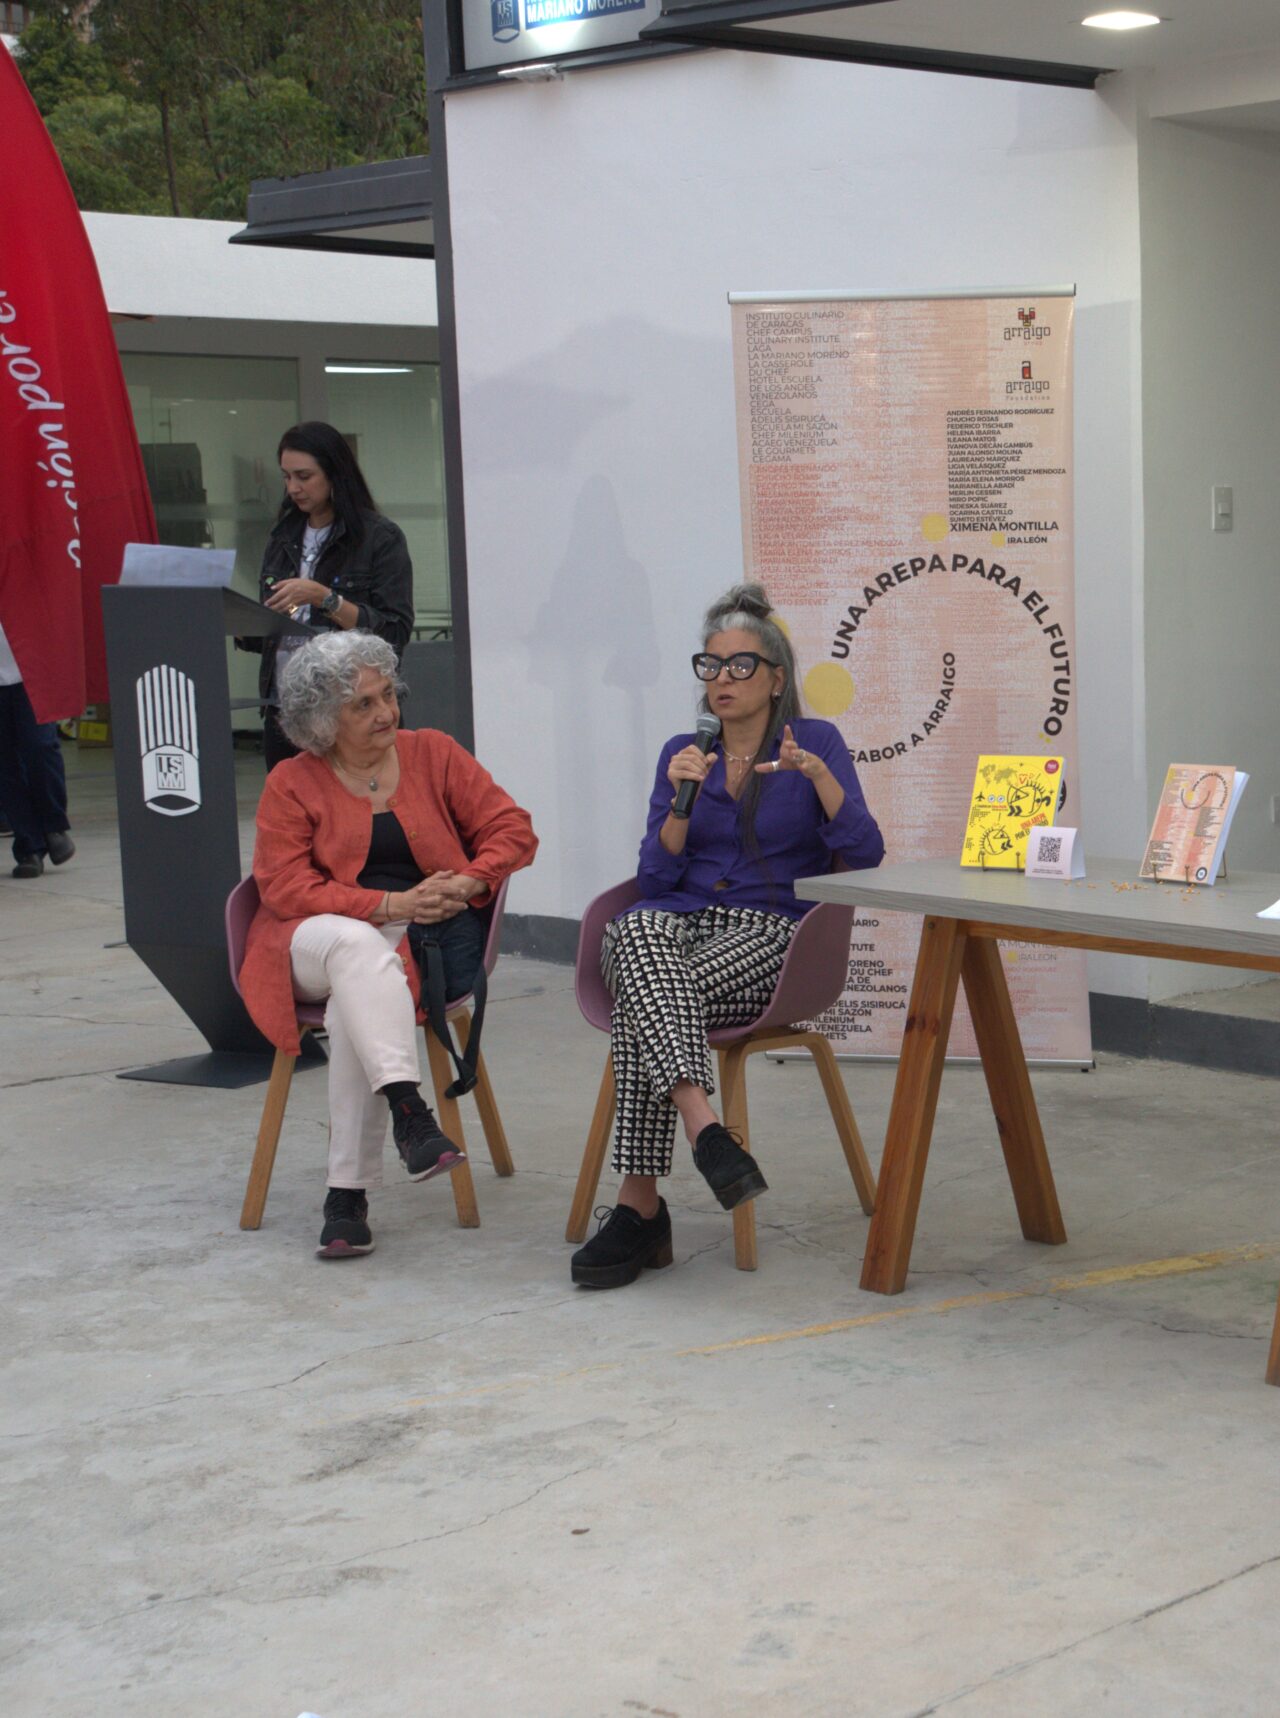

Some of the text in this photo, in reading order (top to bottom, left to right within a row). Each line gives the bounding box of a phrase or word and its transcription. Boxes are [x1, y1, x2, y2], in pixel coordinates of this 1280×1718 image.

[527, 0, 584, 23] MARIANO
[745, 310, 845, 321] INSTITUTO CULINARIO
[746, 320, 805, 329] DE CARACAS
[746, 327, 812, 337] CHEF CAMPUS
[1004, 325, 1051, 341] arraigo
[747, 335, 841, 344] CULINARY INSTITUTE
[748, 351, 850, 361] LA MARIANO MORENO
[748, 360, 814, 369] LA CASSEROLE
[0, 334, 65, 411] por
[749, 368, 789, 377] DU CHEF
[749, 375, 823, 384] HOTEL ESCUELA
[765, 384, 782, 392] LOS
[783, 383, 816, 391] ANDES
[1005, 381, 1050, 394] arraigo
[749, 392, 818, 400] VENEZOLANOS
[751, 408, 792, 416] ESCUELA
[947, 408, 975, 416] ANDRÉS
[976, 408, 1014, 416] FERNANDO
[751, 415, 783, 424] ADELIS
[752, 423, 792, 432] ESCUELA
[752, 431, 824, 440] CHEF MILENIUM
[784, 438, 838, 447] VENEZUELA
[950, 521, 1059, 532] XIMENA MONTILLA
[1025, 535, 1048, 543] LEÓN
[831, 553, 1071, 737] UNA AREPA PARA EL FUTURO
[849, 652, 956, 764] SABOR A ARRAIGO
[848, 960, 885, 968] ORENO
[850, 968, 894, 976] DU CHEF
[857, 976, 871, 984] DE
[843, 984, 908, 993] NEZOLANOS
[832, 999, 906, 1009] DELIS SISIRUCÁ
[824, 1007, 872, 1016] MI SAZÓN
[814, 1024, 872, 1033] VENEZUELA
